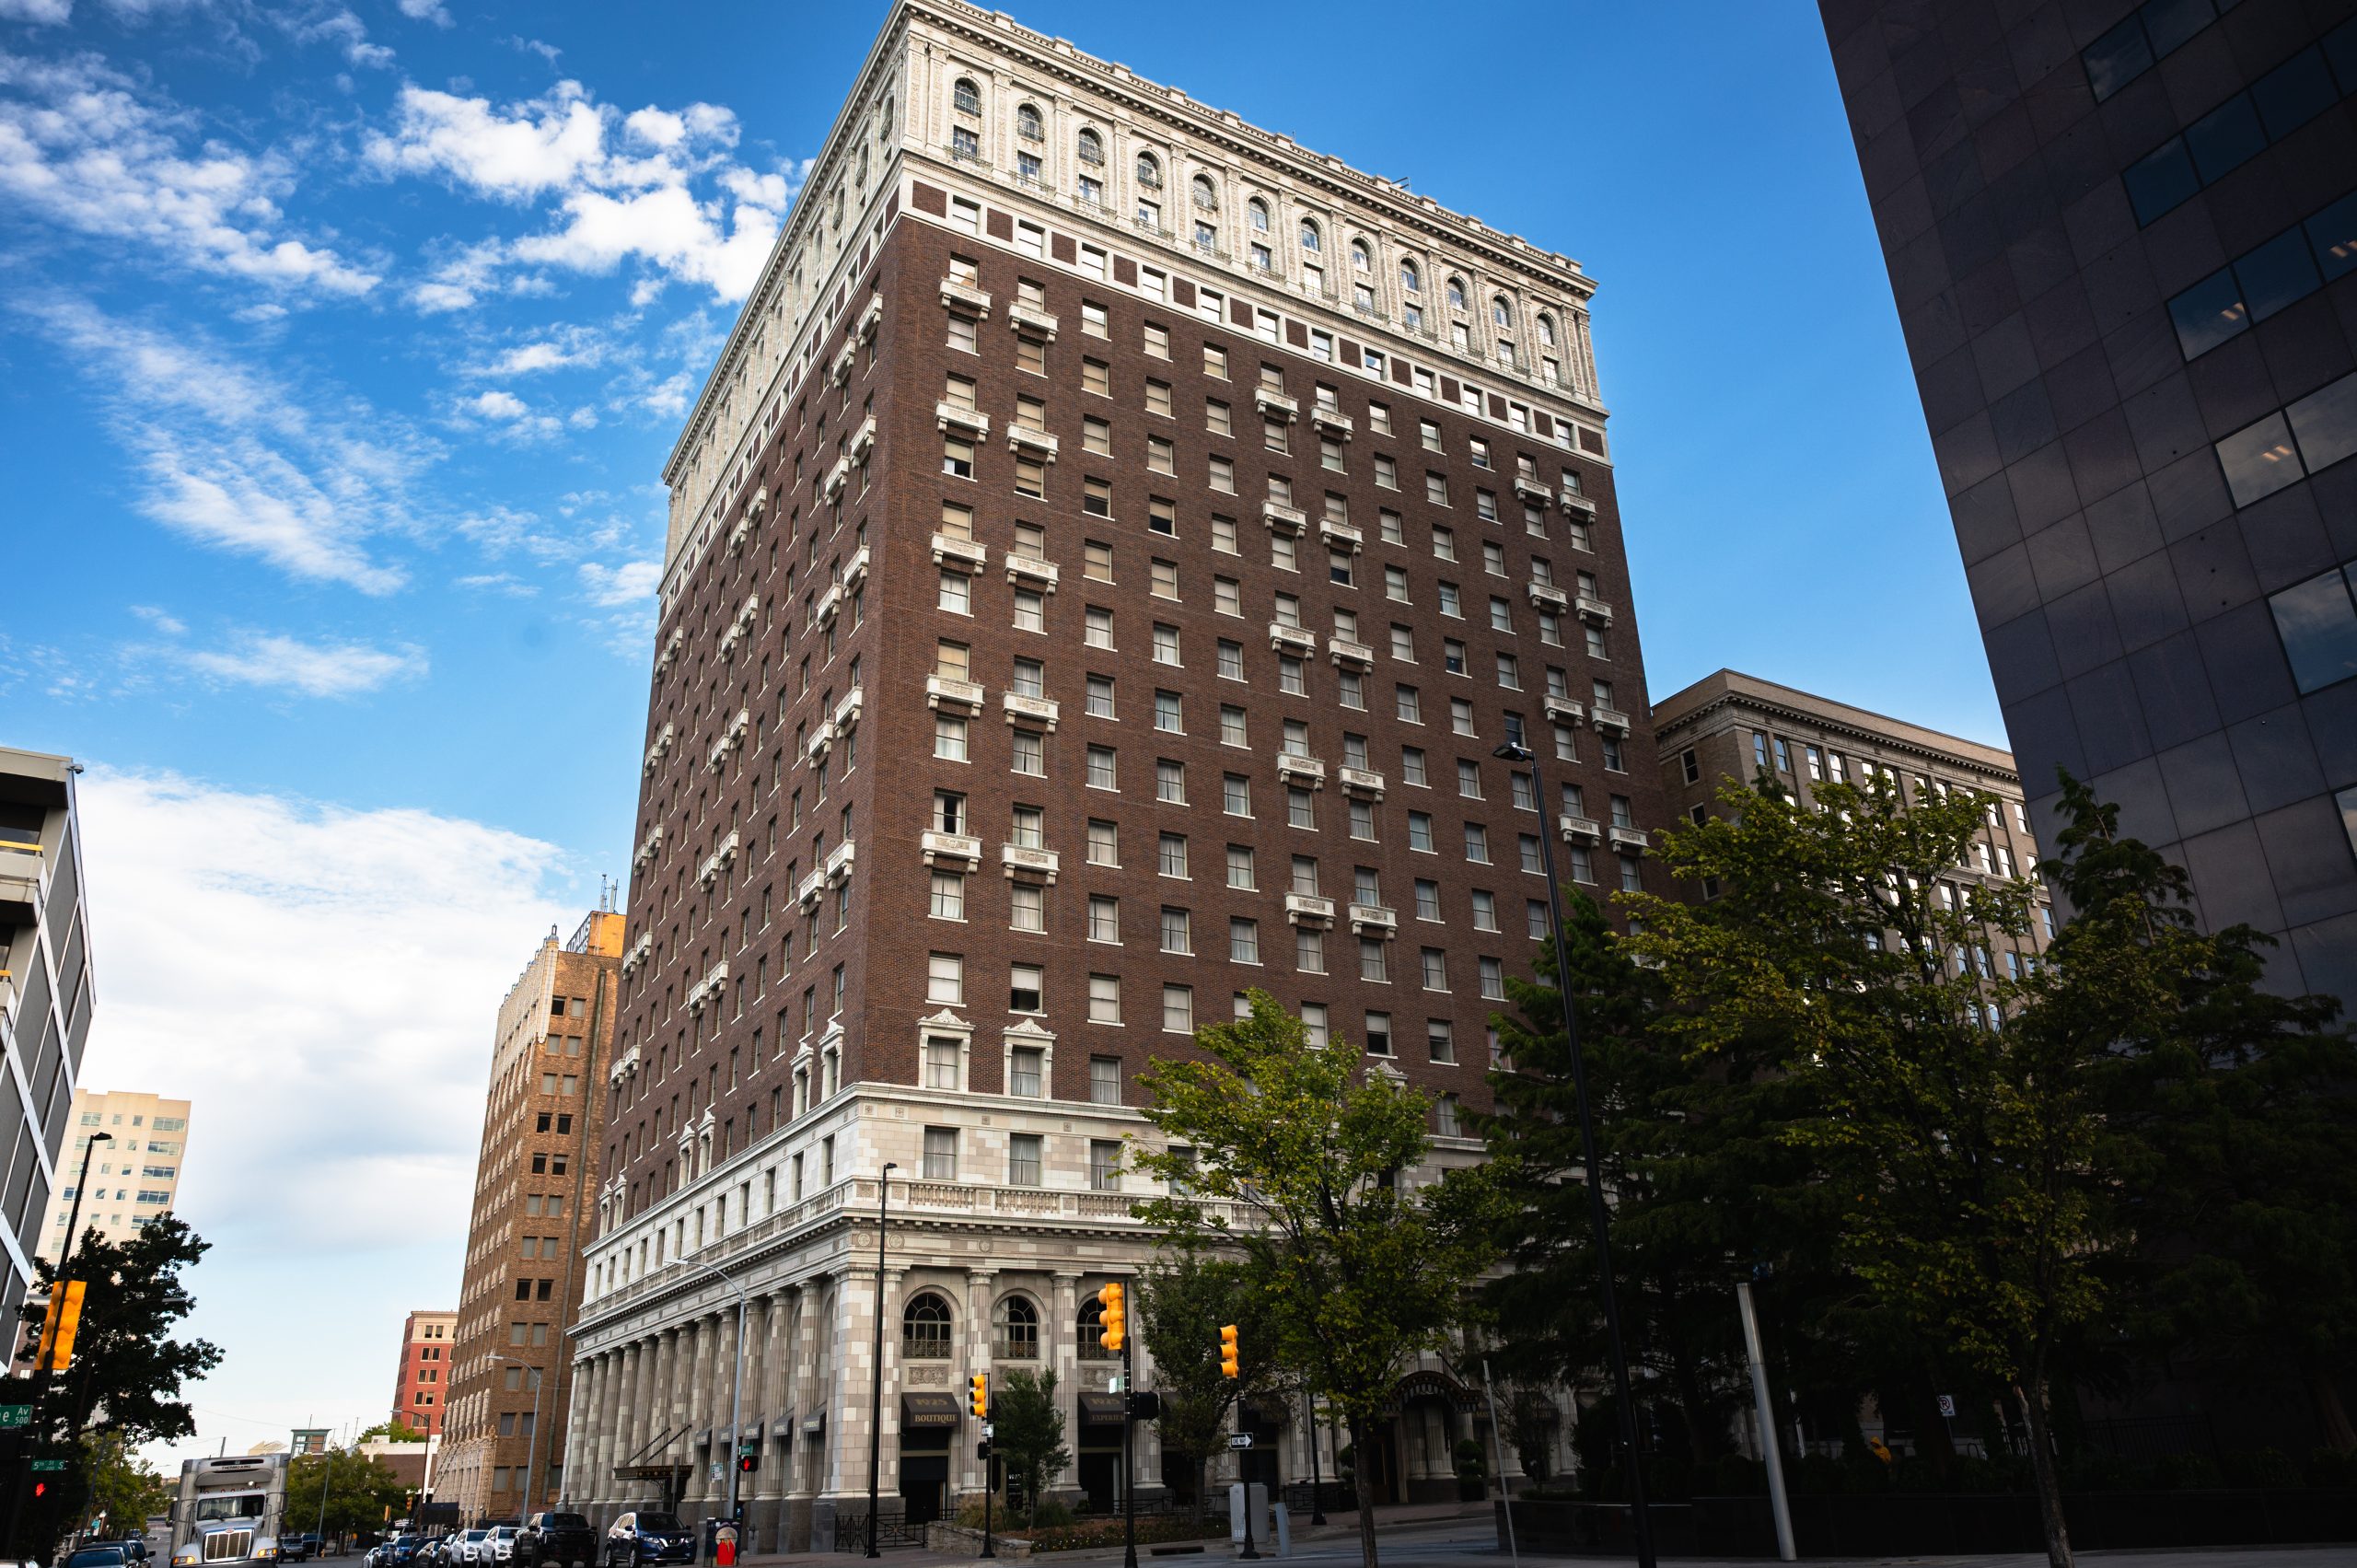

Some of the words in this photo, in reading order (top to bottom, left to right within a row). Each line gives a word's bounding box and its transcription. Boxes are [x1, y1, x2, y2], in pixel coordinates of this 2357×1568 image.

[915, 1398, 947, 1406] 1925
[17, 1407, 29, 1416] Av
[15, 1416, 29, 1424] 500
[914, 1414, 958, 1423] BOUTIQUE
